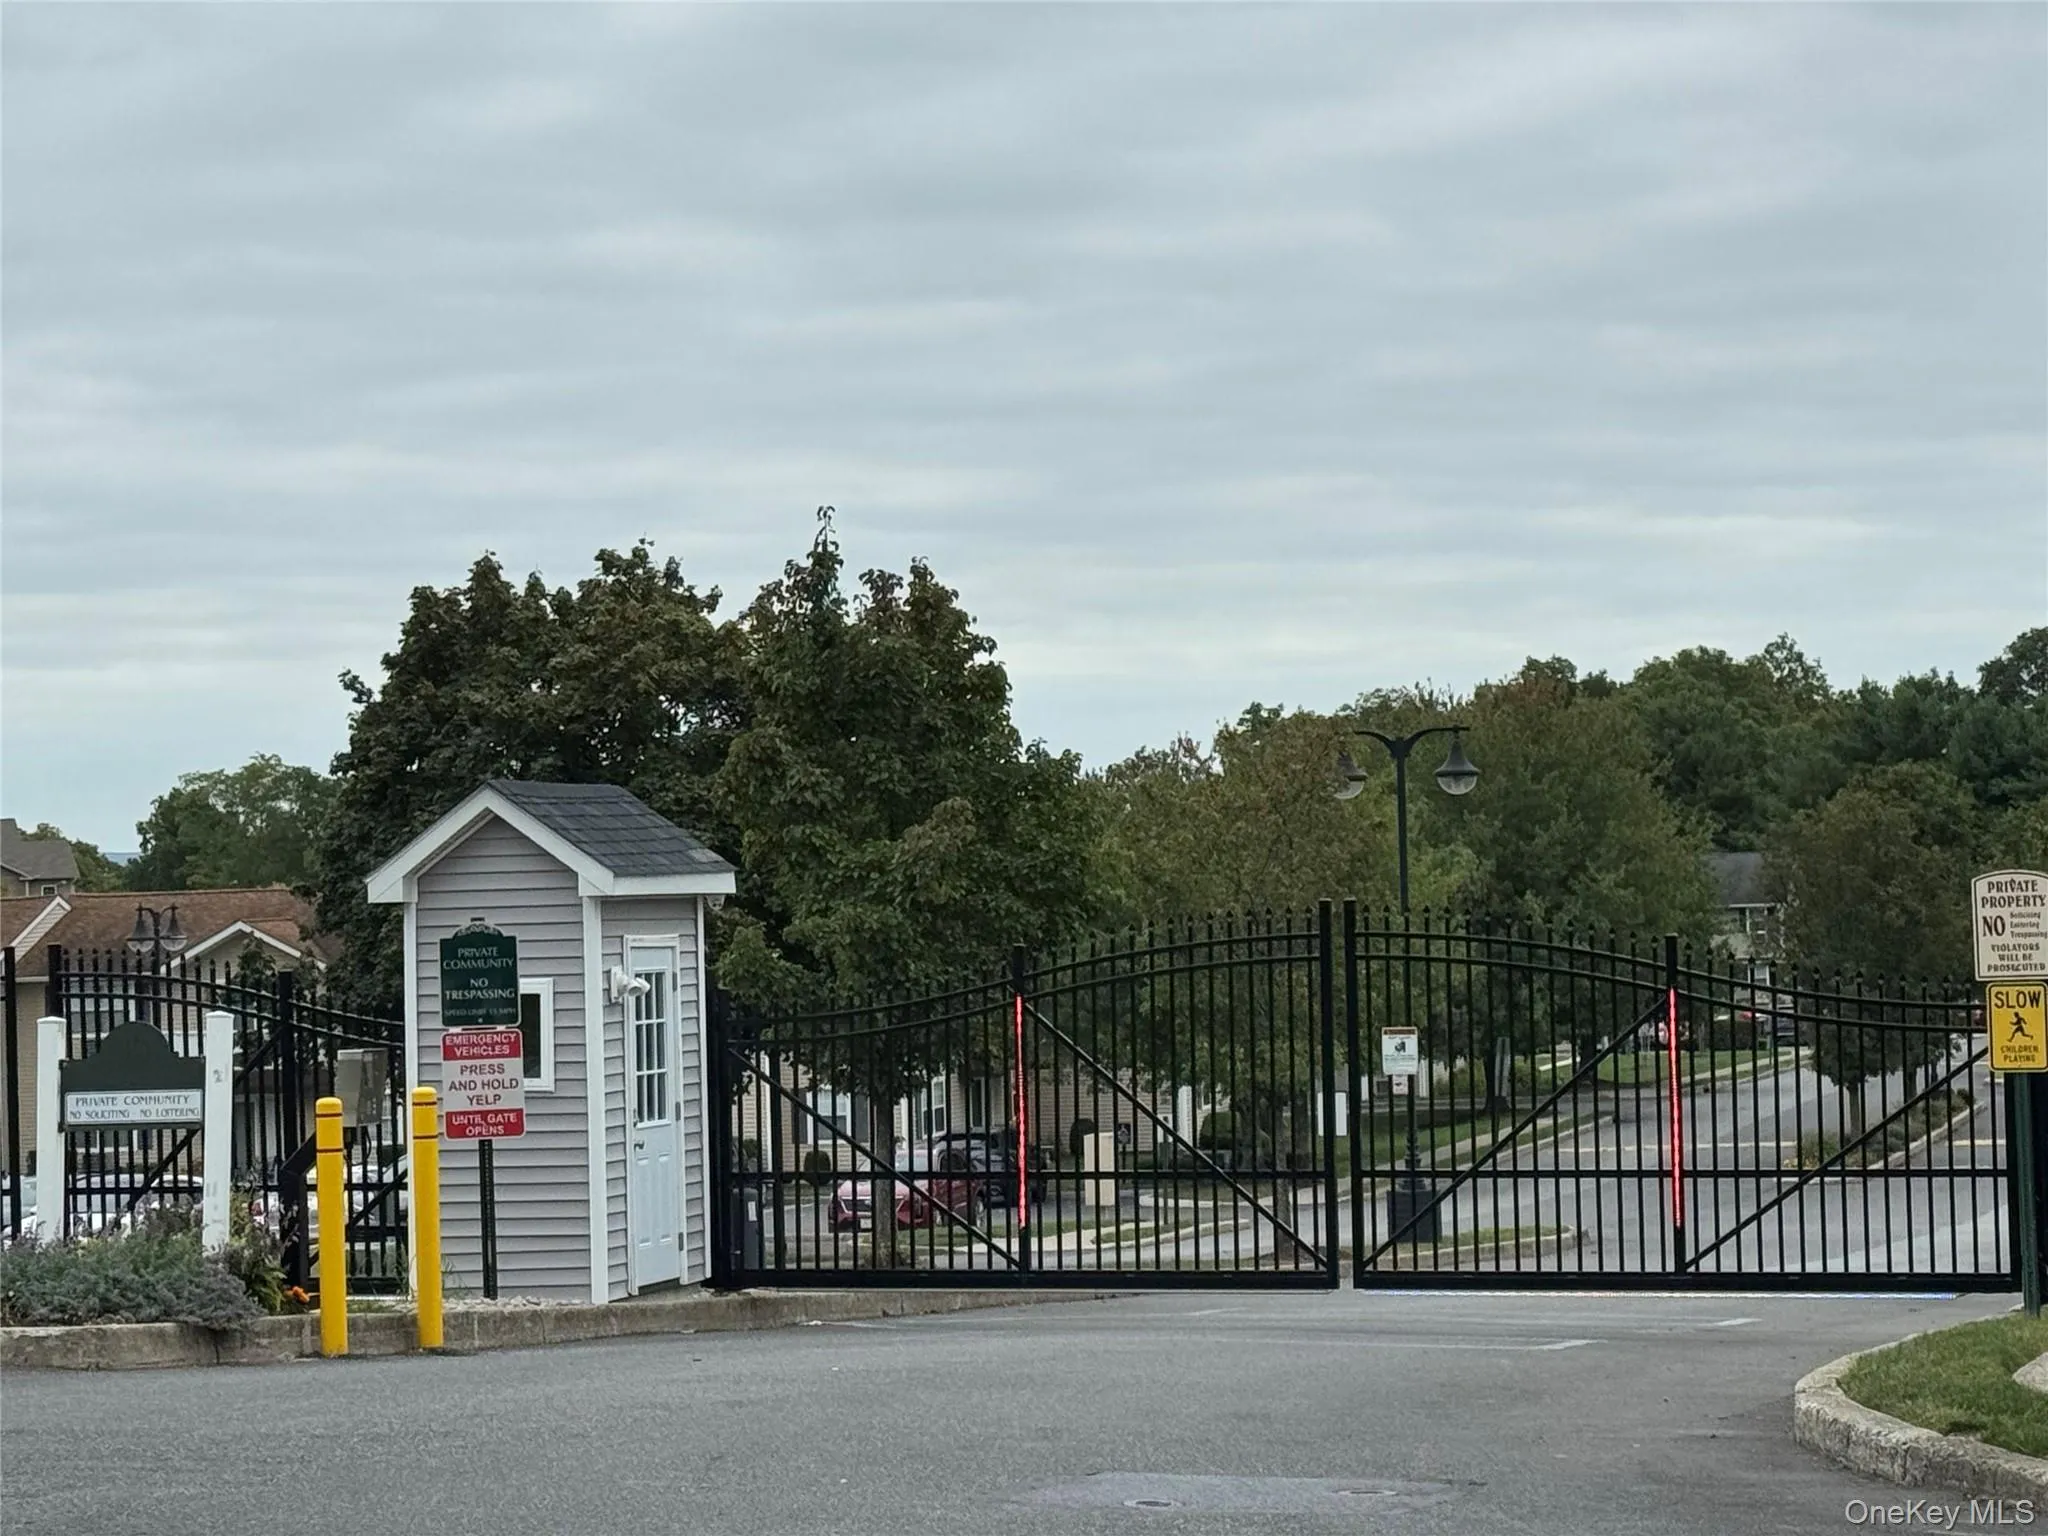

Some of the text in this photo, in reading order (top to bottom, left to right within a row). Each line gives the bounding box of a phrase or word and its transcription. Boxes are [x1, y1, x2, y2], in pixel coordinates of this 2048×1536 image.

[1987, 880, 2038, 893] PRIVATE
[1981, 895, 2047, 908] PROPERTY
[1982, 915, 2006, 937] NO
[457, 947, 499, 958] PRIVATE
[1991, 943, 2040, 953] VIOLATORS
[1998, 953, 2033, 962] WILL BE
[443, 958, 515, 970] COMMUNITY
[1987, 963, 2046, 972] PROSECUTED
[470, 977, 488, 988] NO
[445, 988, 516, 1000] TRESPASSING
[1994, 990, 2042, 1009] SLOW
[445, 1033, 517, 1045] EMERGENCY
[454, 1045, 510, 1056] VEHICLES
[2000, 1044, 2040, 1054] CHILDREN
[2003, 1054, 2036, 1062] PLAYING
[460, 1063, 505, 1075] PRESS
[448, 1078, 519, 1091] AND HOLD
[75, 1095, 190, 1106] PRIVATE COMMUNITY
[467, 1094, 502, 1106] YELP
[70, 1110, 81, 1119] NO
[140, 1109, 152, 1118] NO
[452, 1112, 517, 1125] UNTIL GATE
[466, 1125, 504, 1136] OPENS
